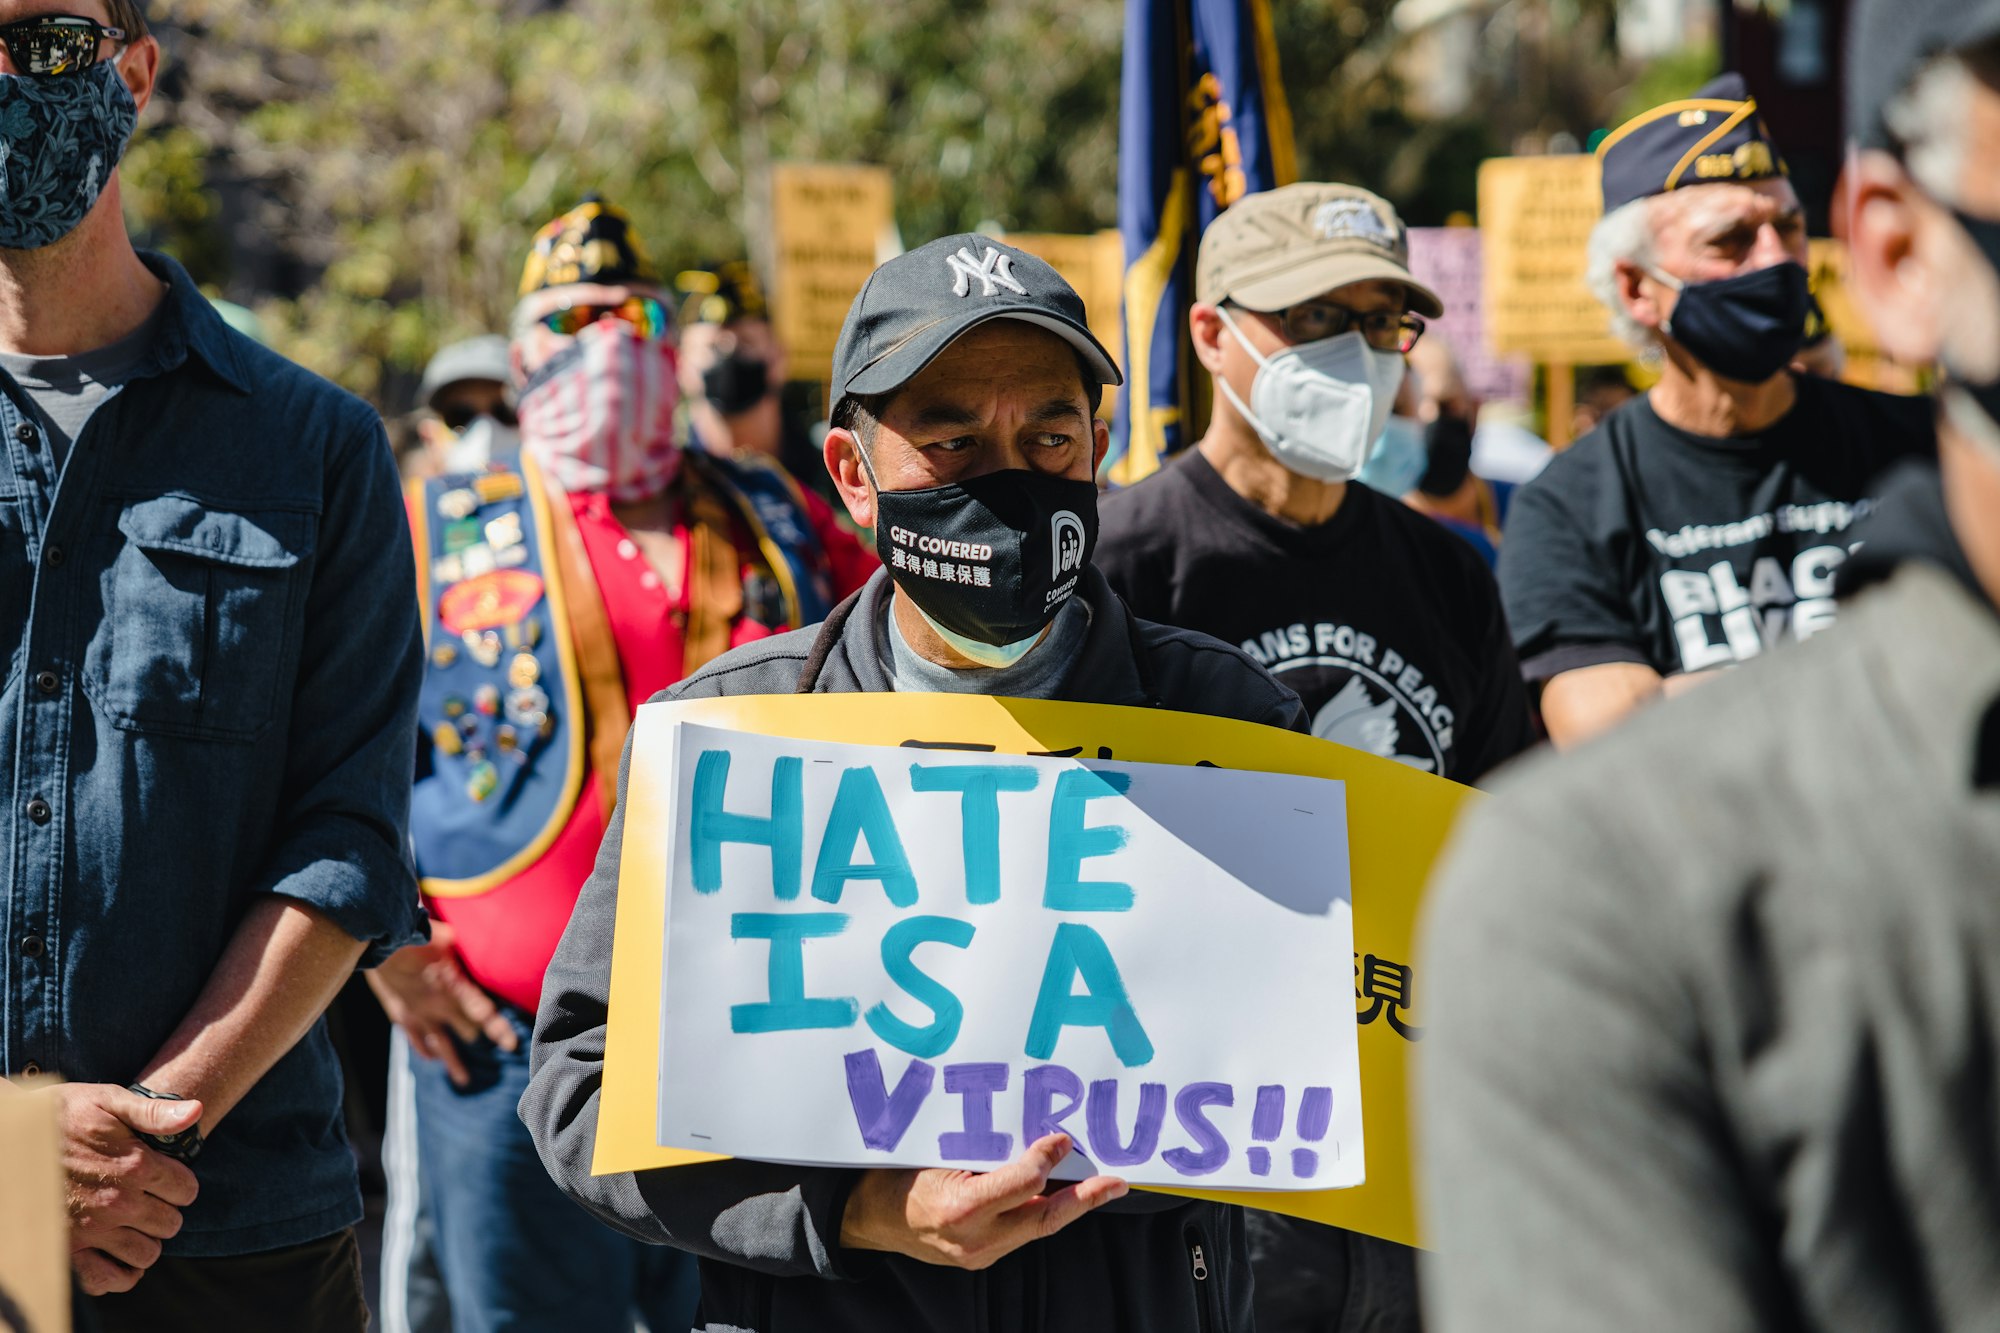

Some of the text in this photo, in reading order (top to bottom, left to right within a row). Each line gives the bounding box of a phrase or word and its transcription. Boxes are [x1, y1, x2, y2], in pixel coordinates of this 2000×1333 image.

[946, 247, 1028, 297] NY
[890, 525, 993, 561] GET COVERED
[891, 547, 992, 588] 獲得健康保護
[1660, 541, 1864, 621] BLAC
[1314, 623, 1377, 665] FOR
[690, 750, 1137, 912] HATE
[730, 912, 1155, 1067] IS A
[844, 1048, 1334, 1179] VIRUS!!
